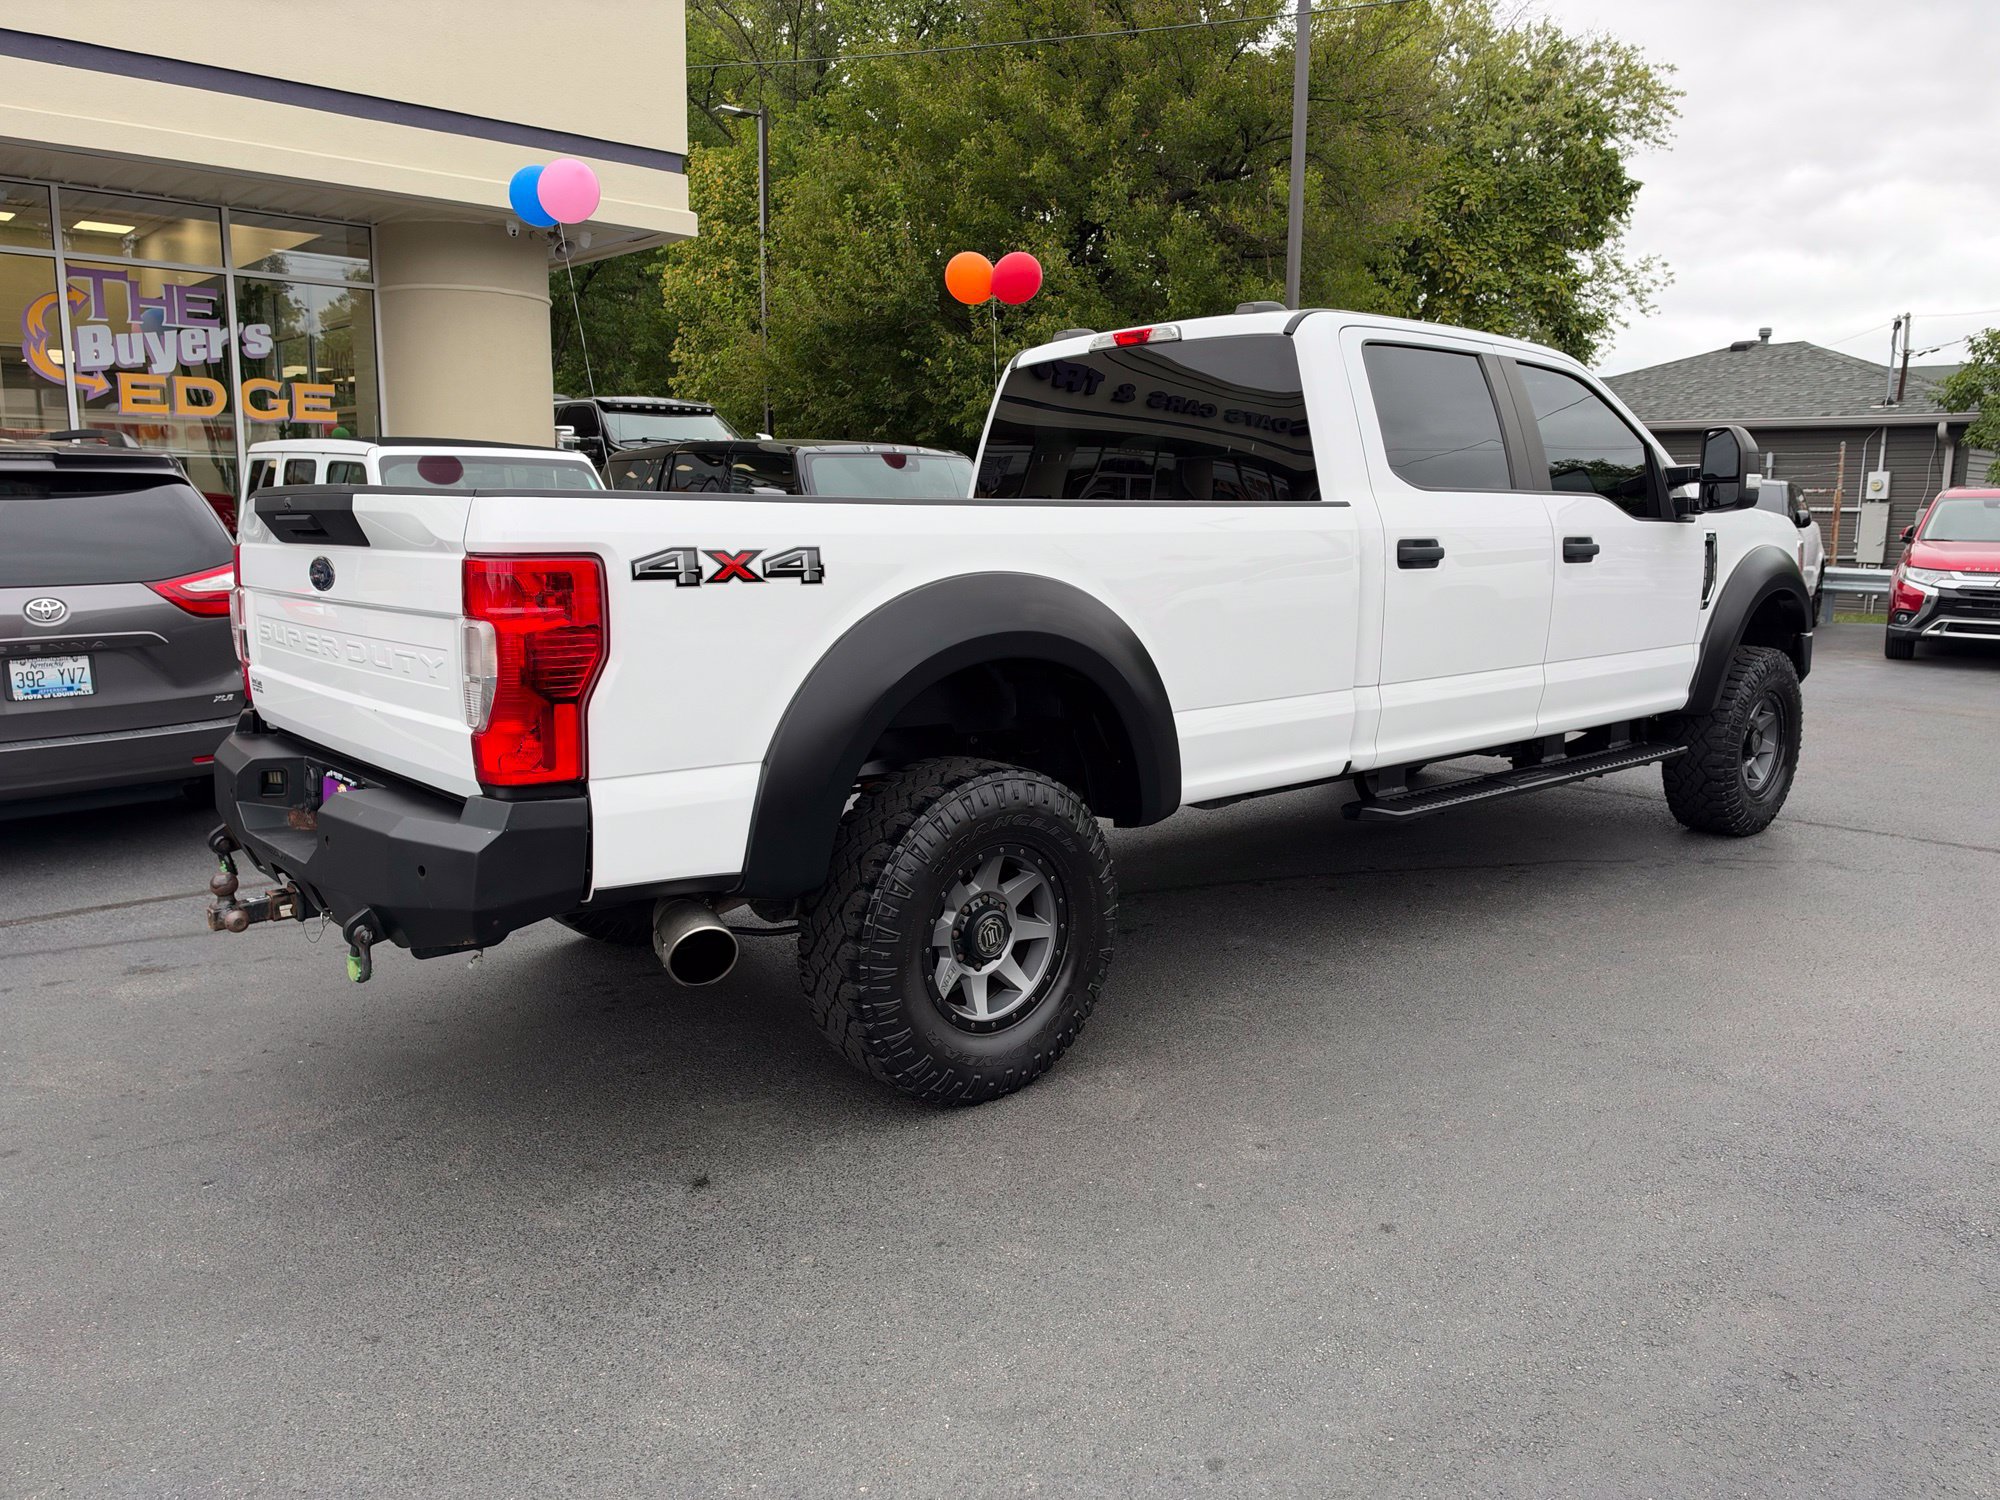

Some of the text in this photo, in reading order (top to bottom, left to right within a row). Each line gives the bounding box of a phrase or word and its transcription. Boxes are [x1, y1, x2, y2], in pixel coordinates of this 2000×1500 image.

[65, 264, 220, 329] THE
[76, 322, 274, 376] Buyer's
[117, 373, 338, 424] EDGE
[260, 622, 444, 679] SUPER DUTY
[14, 693, 43, 701] TOYOTA
[52, 689, 94, 698] LOUISVILLE
[15, 667, 87, 689] 392 YVZ
